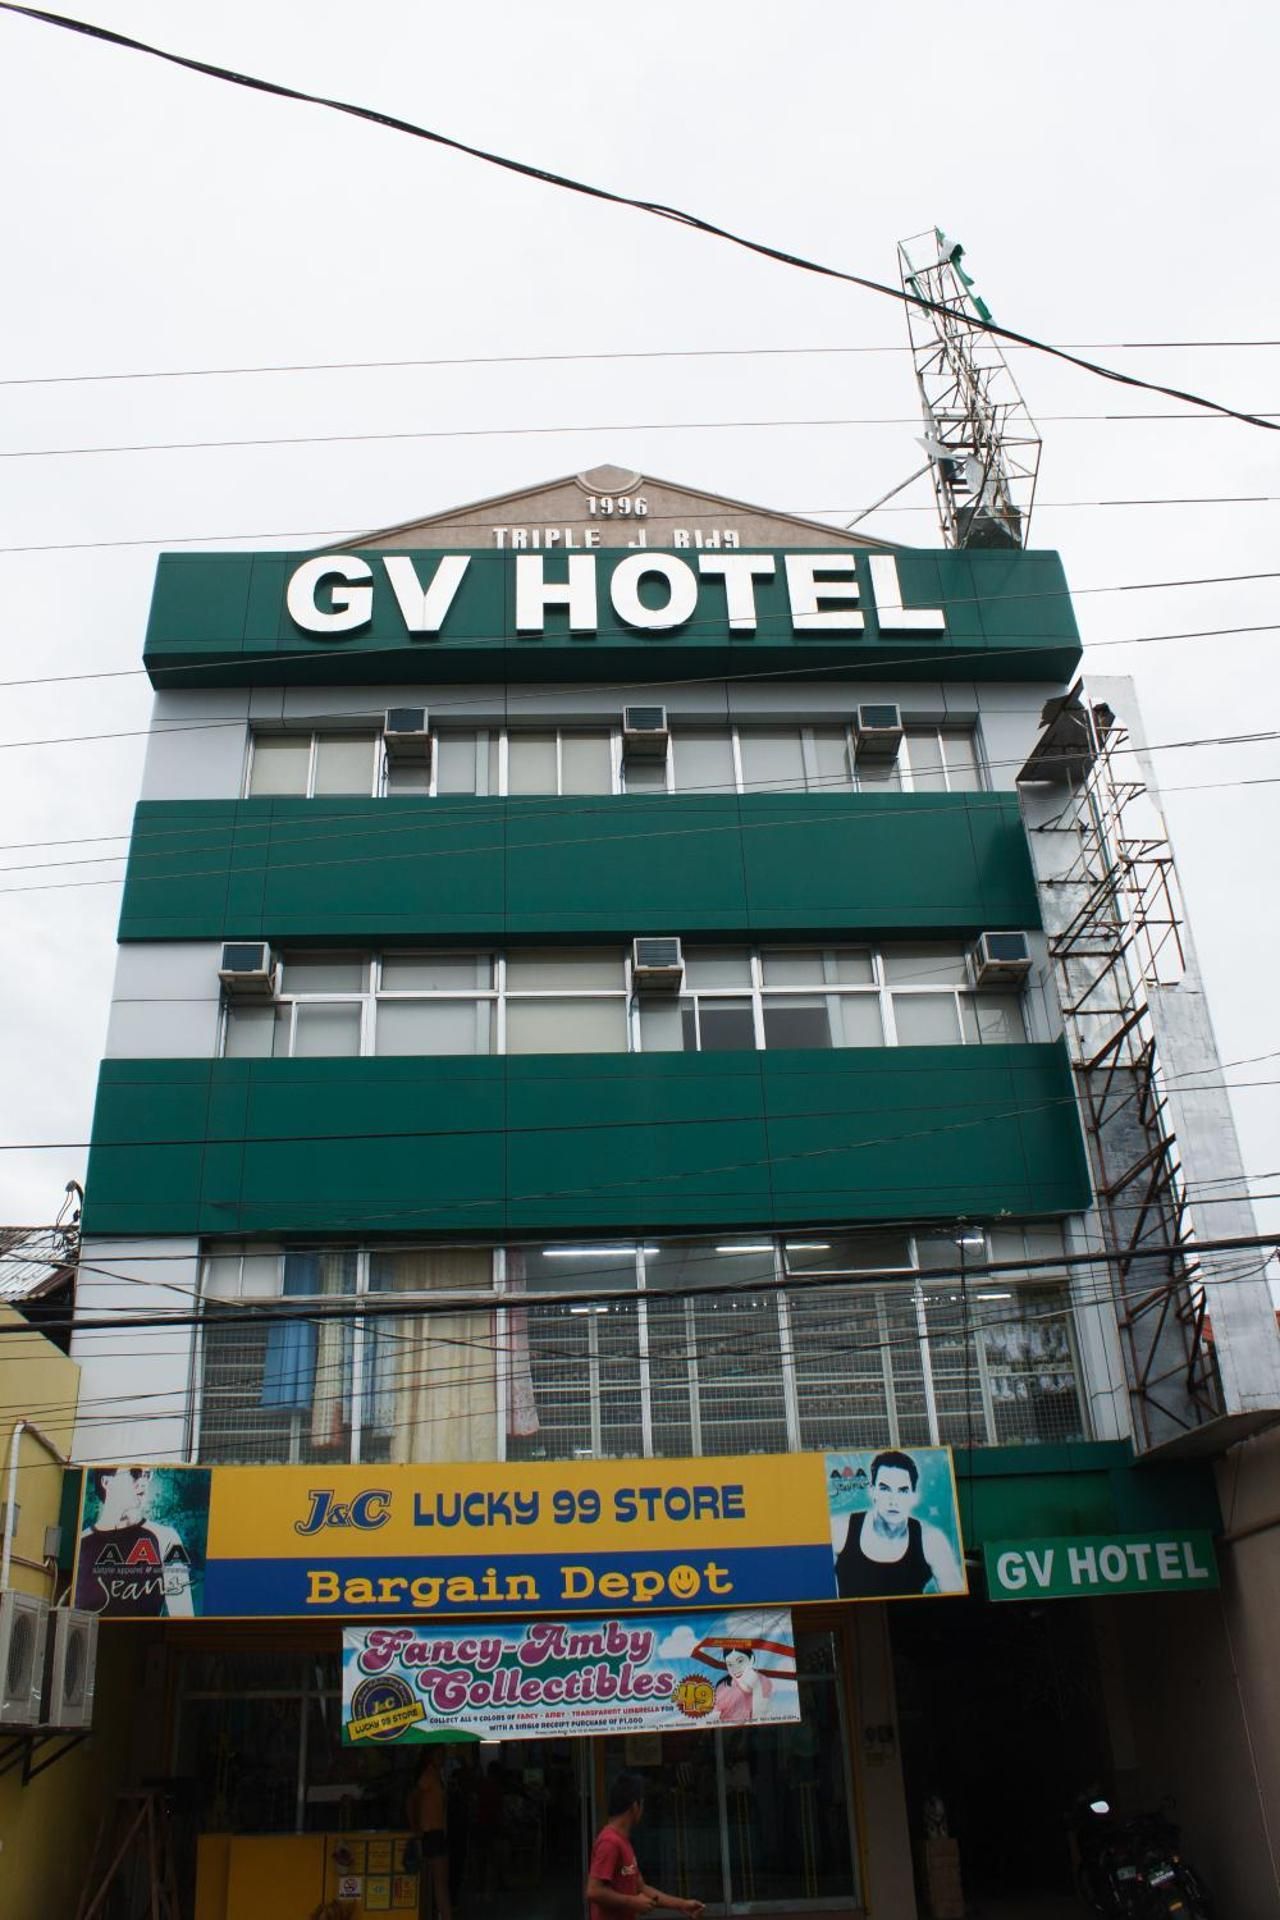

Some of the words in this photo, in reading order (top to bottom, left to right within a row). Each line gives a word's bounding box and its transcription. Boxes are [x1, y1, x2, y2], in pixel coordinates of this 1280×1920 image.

[586, 496, 649, 516] 1996
[493, 528, 600, 548] TRIPLE
[628, 529, 647, 548] J
[286, 554, 471, 638] GV
[515, 554, 945, 634] HOTEL
[295, 1488, 391, 1535] J&C
[414, 1490, 539, 1528] LUCKY
[552, 1489, 601, 1525] 99
[614, 1484, 745, 1523] STORE
[94, 1537, 191, 1566] AAA
[996, 1549, 1055, 1590] GV
[1067, 1541, 1209, 1585] HOTEL
[306, 1568, 540, 1608] Bargain
[419, 1663, 674, 1711] Collectibles
[392, 1708, 419, 1722] STORE
[429, 1716, 459, 1724] COLLECT
[460, 1715, 472, 1723] ALL
[480, 1713, 505, 1722] COLORS
[489, 1724, 508, 1732] WITH
